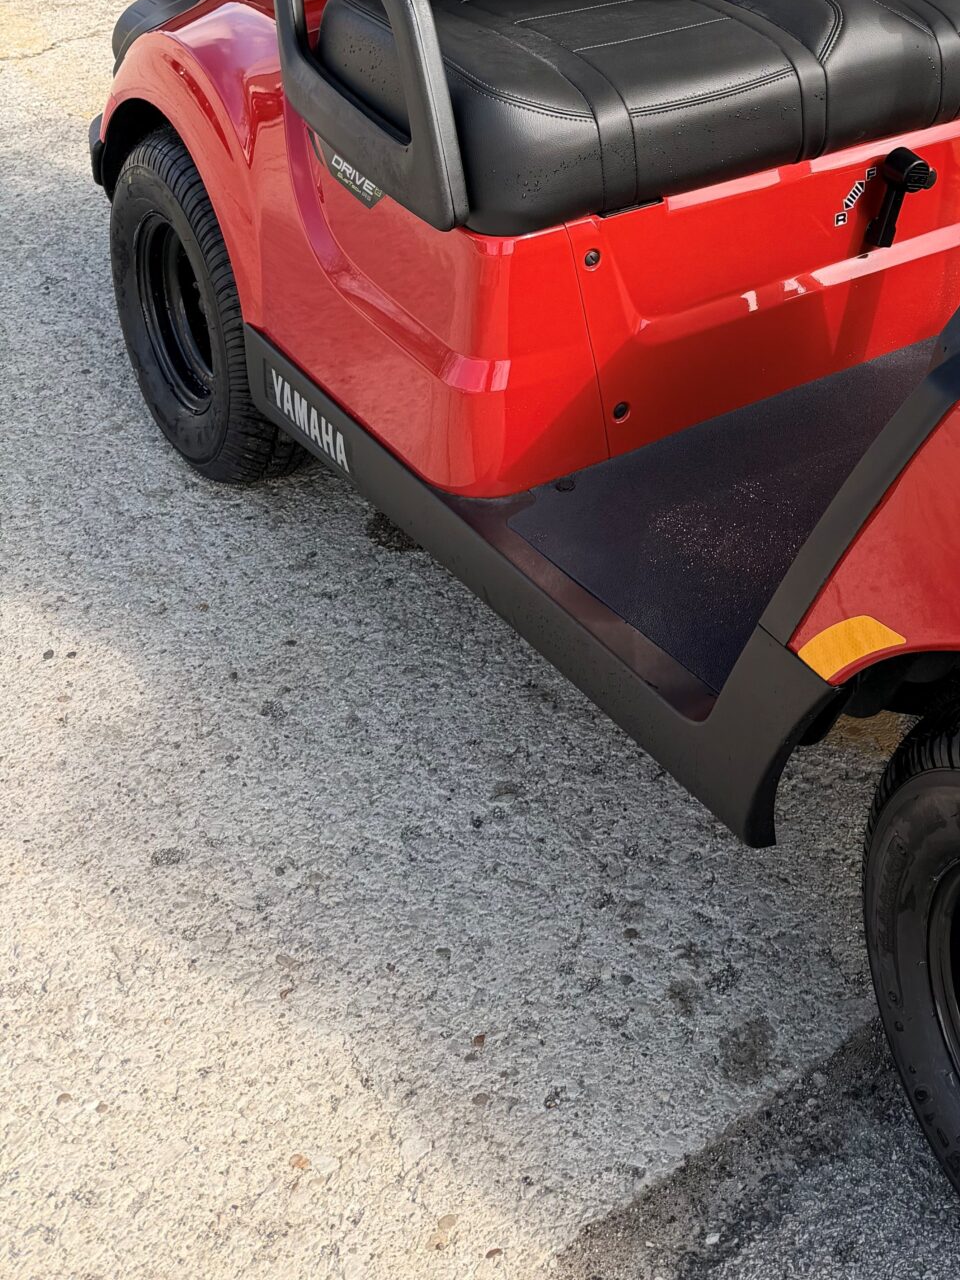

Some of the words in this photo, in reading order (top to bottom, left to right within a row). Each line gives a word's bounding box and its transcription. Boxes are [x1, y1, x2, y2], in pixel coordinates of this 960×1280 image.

[865, 167, 876, 181] F
[835, 212, 848, 227] R
[271, 368, 350, 473] YAMAHA
